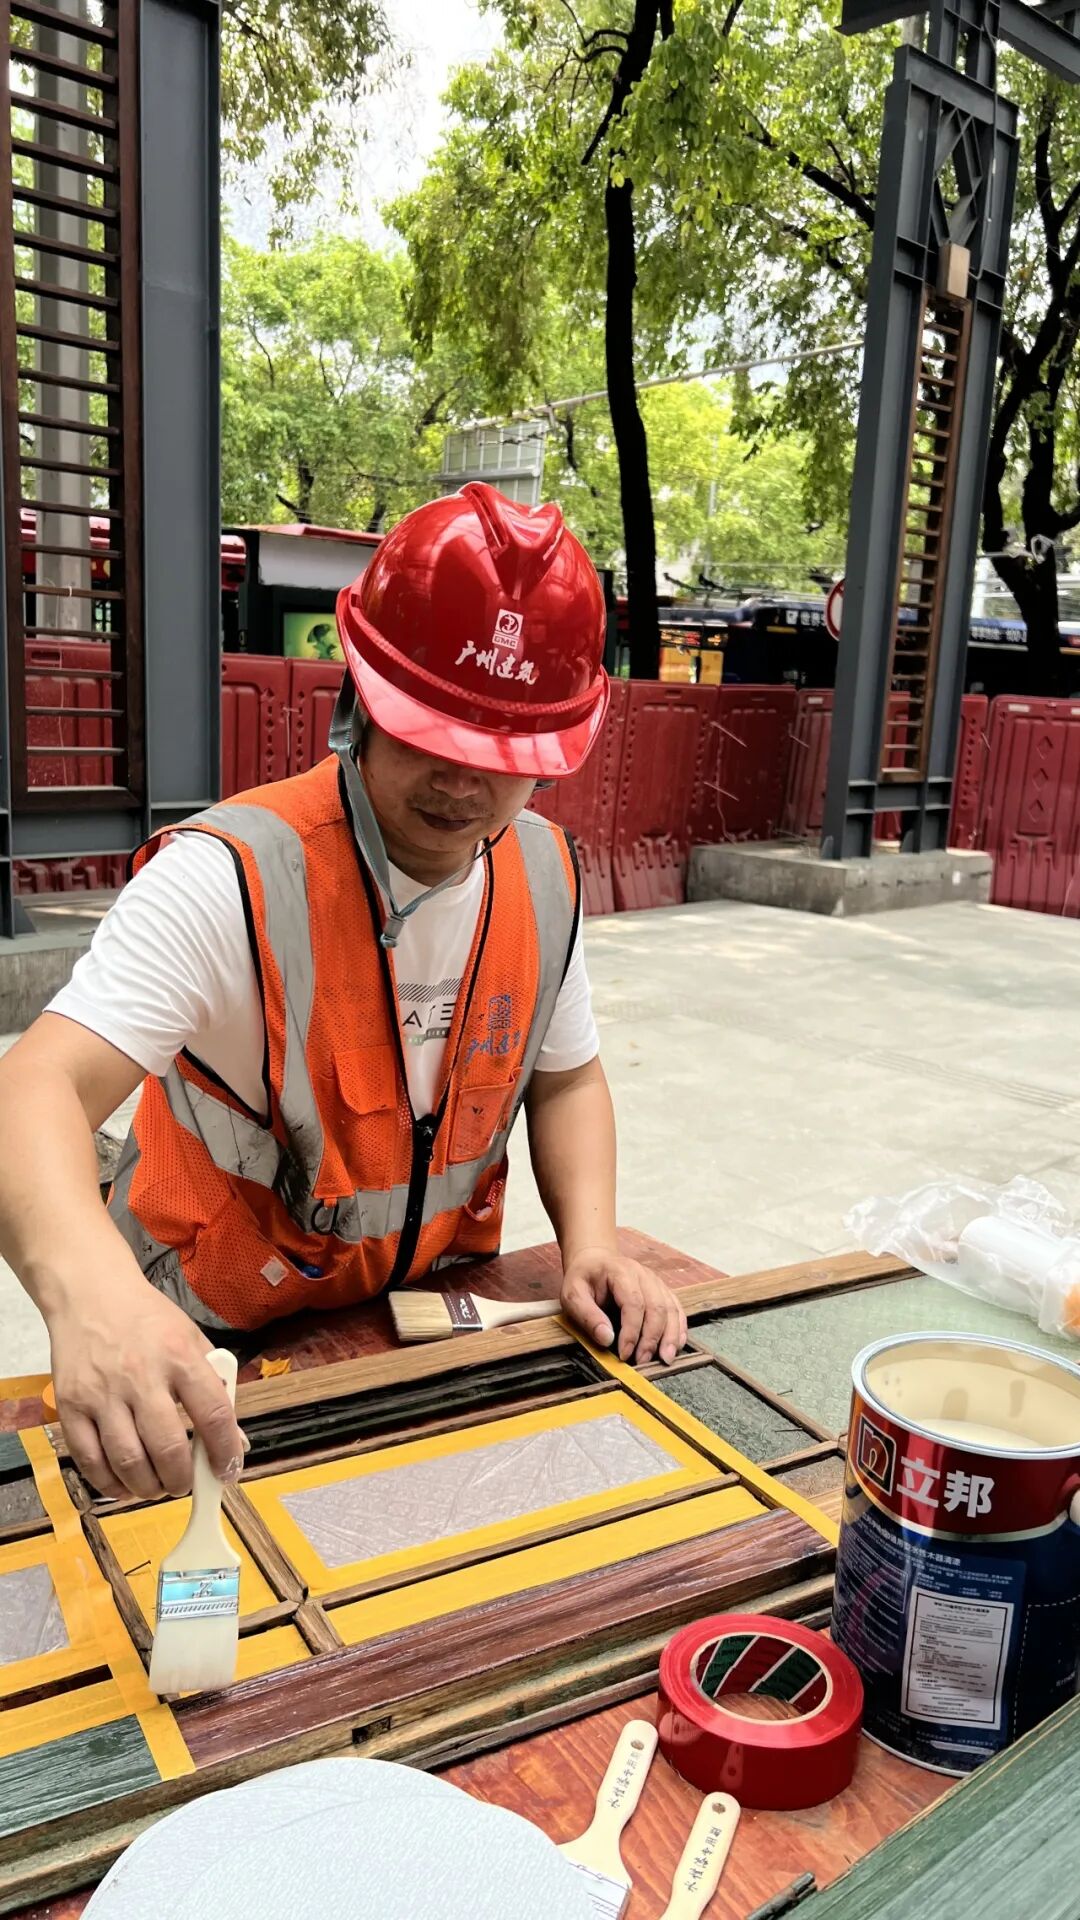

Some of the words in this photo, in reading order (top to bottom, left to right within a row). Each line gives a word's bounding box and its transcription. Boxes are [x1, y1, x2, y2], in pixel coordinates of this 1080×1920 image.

[455, 640, 538, 685] 广州建筑
[897, 1456, 995, 1518] 立邦
